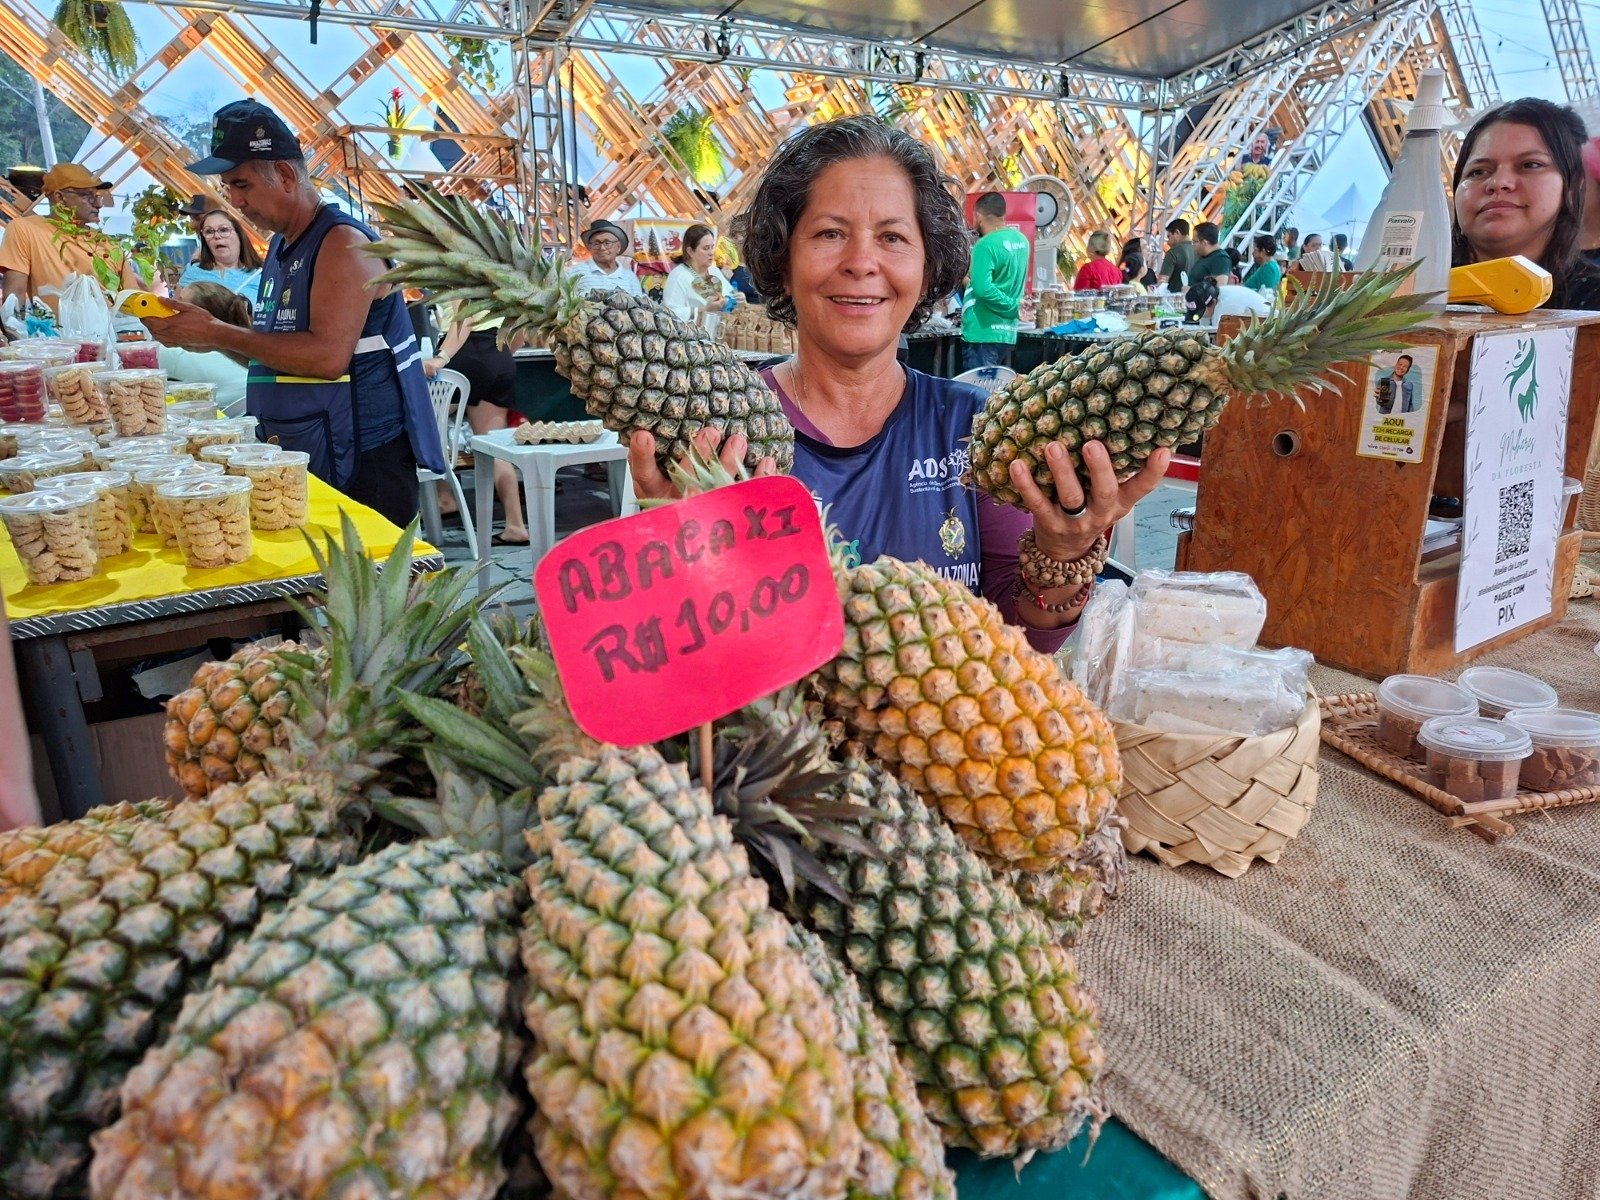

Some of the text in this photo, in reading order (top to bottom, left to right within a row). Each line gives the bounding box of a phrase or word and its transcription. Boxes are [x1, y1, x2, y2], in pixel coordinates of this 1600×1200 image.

[1383, 417, 1405, 427] AQUI
[1385, 428, 1413, 437] RECARGA
[1383, 436, 1410, 445] CELULAR
[908, 457, 948, 481] ADS
[558, 505, 802, 614] ABACAXI
[1493, 583, 1525, 604] PAGUE COM
[1497, 601, 1516, 626] PIX
